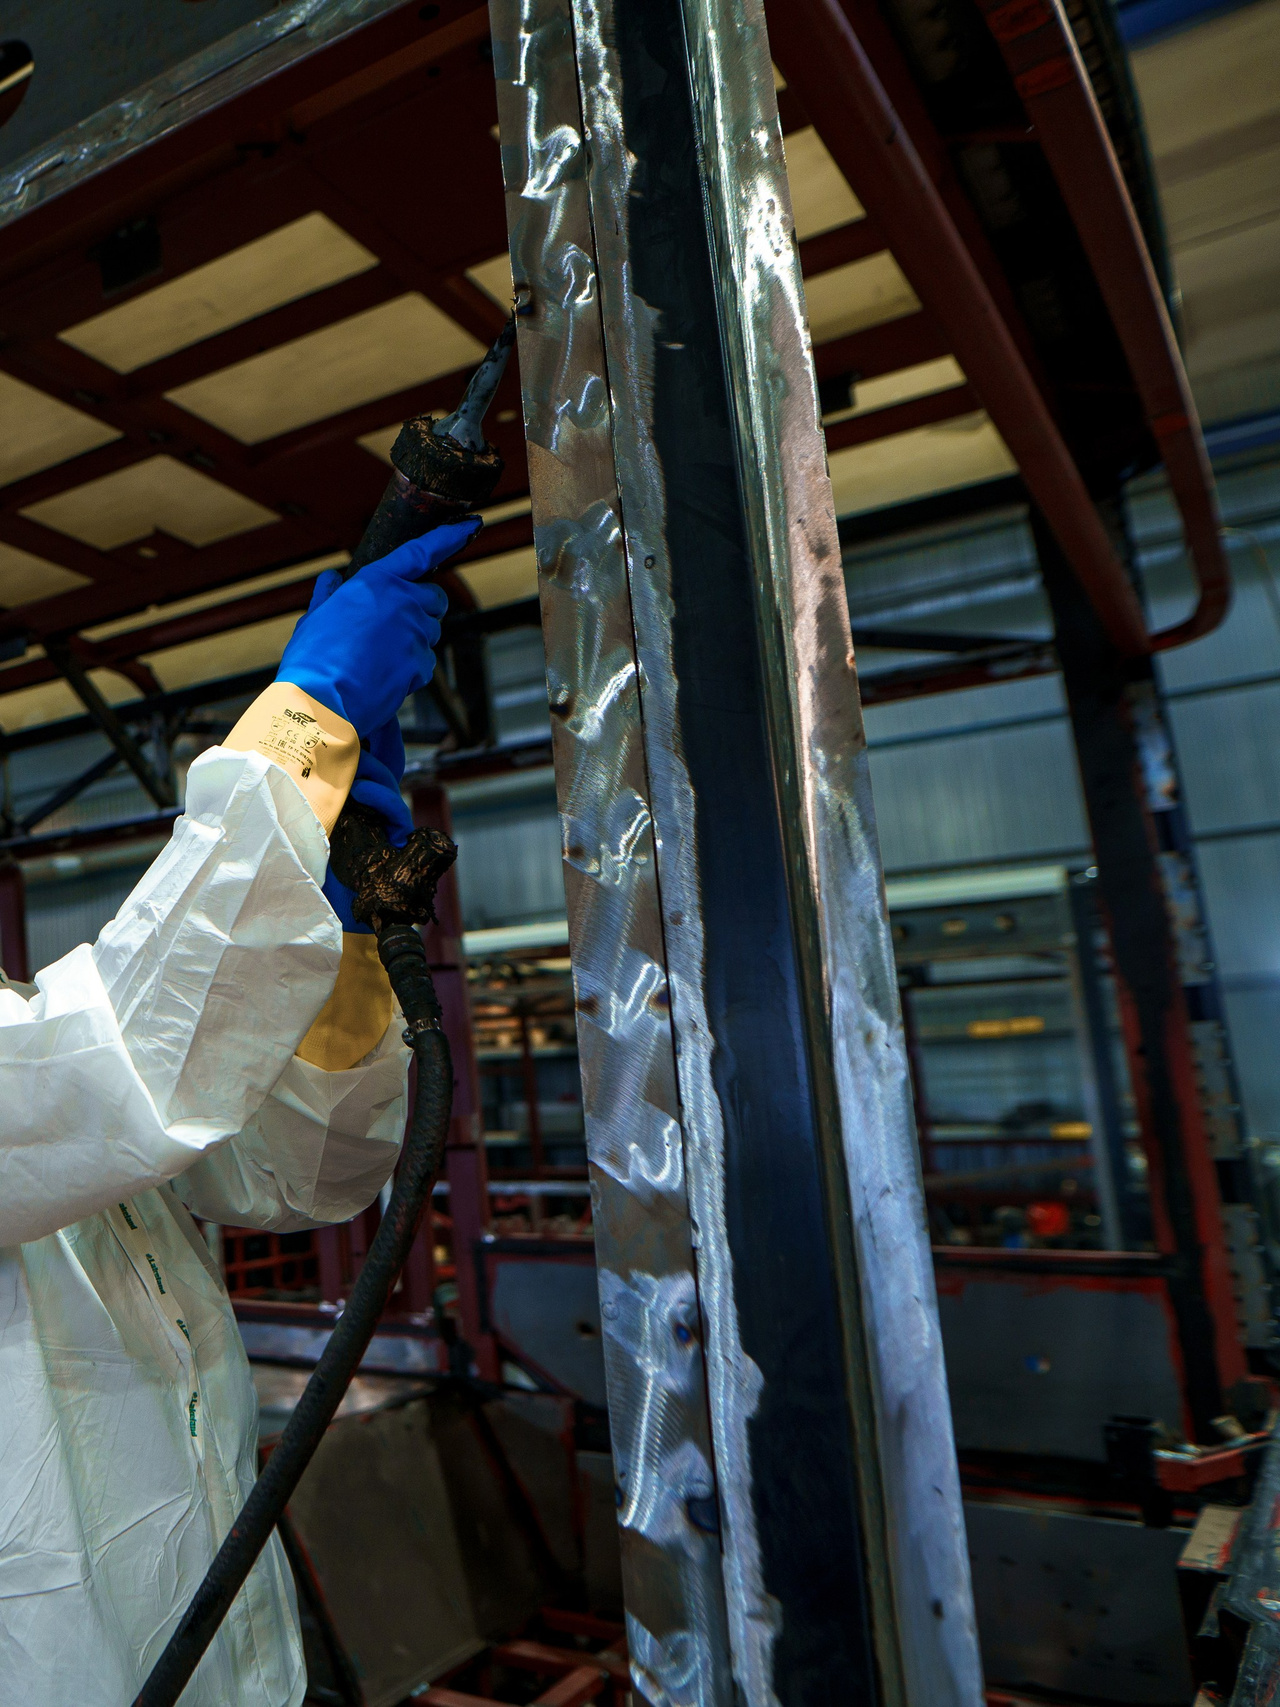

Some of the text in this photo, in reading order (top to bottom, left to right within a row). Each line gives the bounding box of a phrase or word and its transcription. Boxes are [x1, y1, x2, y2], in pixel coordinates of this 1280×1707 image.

[119, 1203, 138, 1230] akeland
[147, 1259, 166, 1295] Lakeland
[189, 1399, 198, 1437] Lakeland
